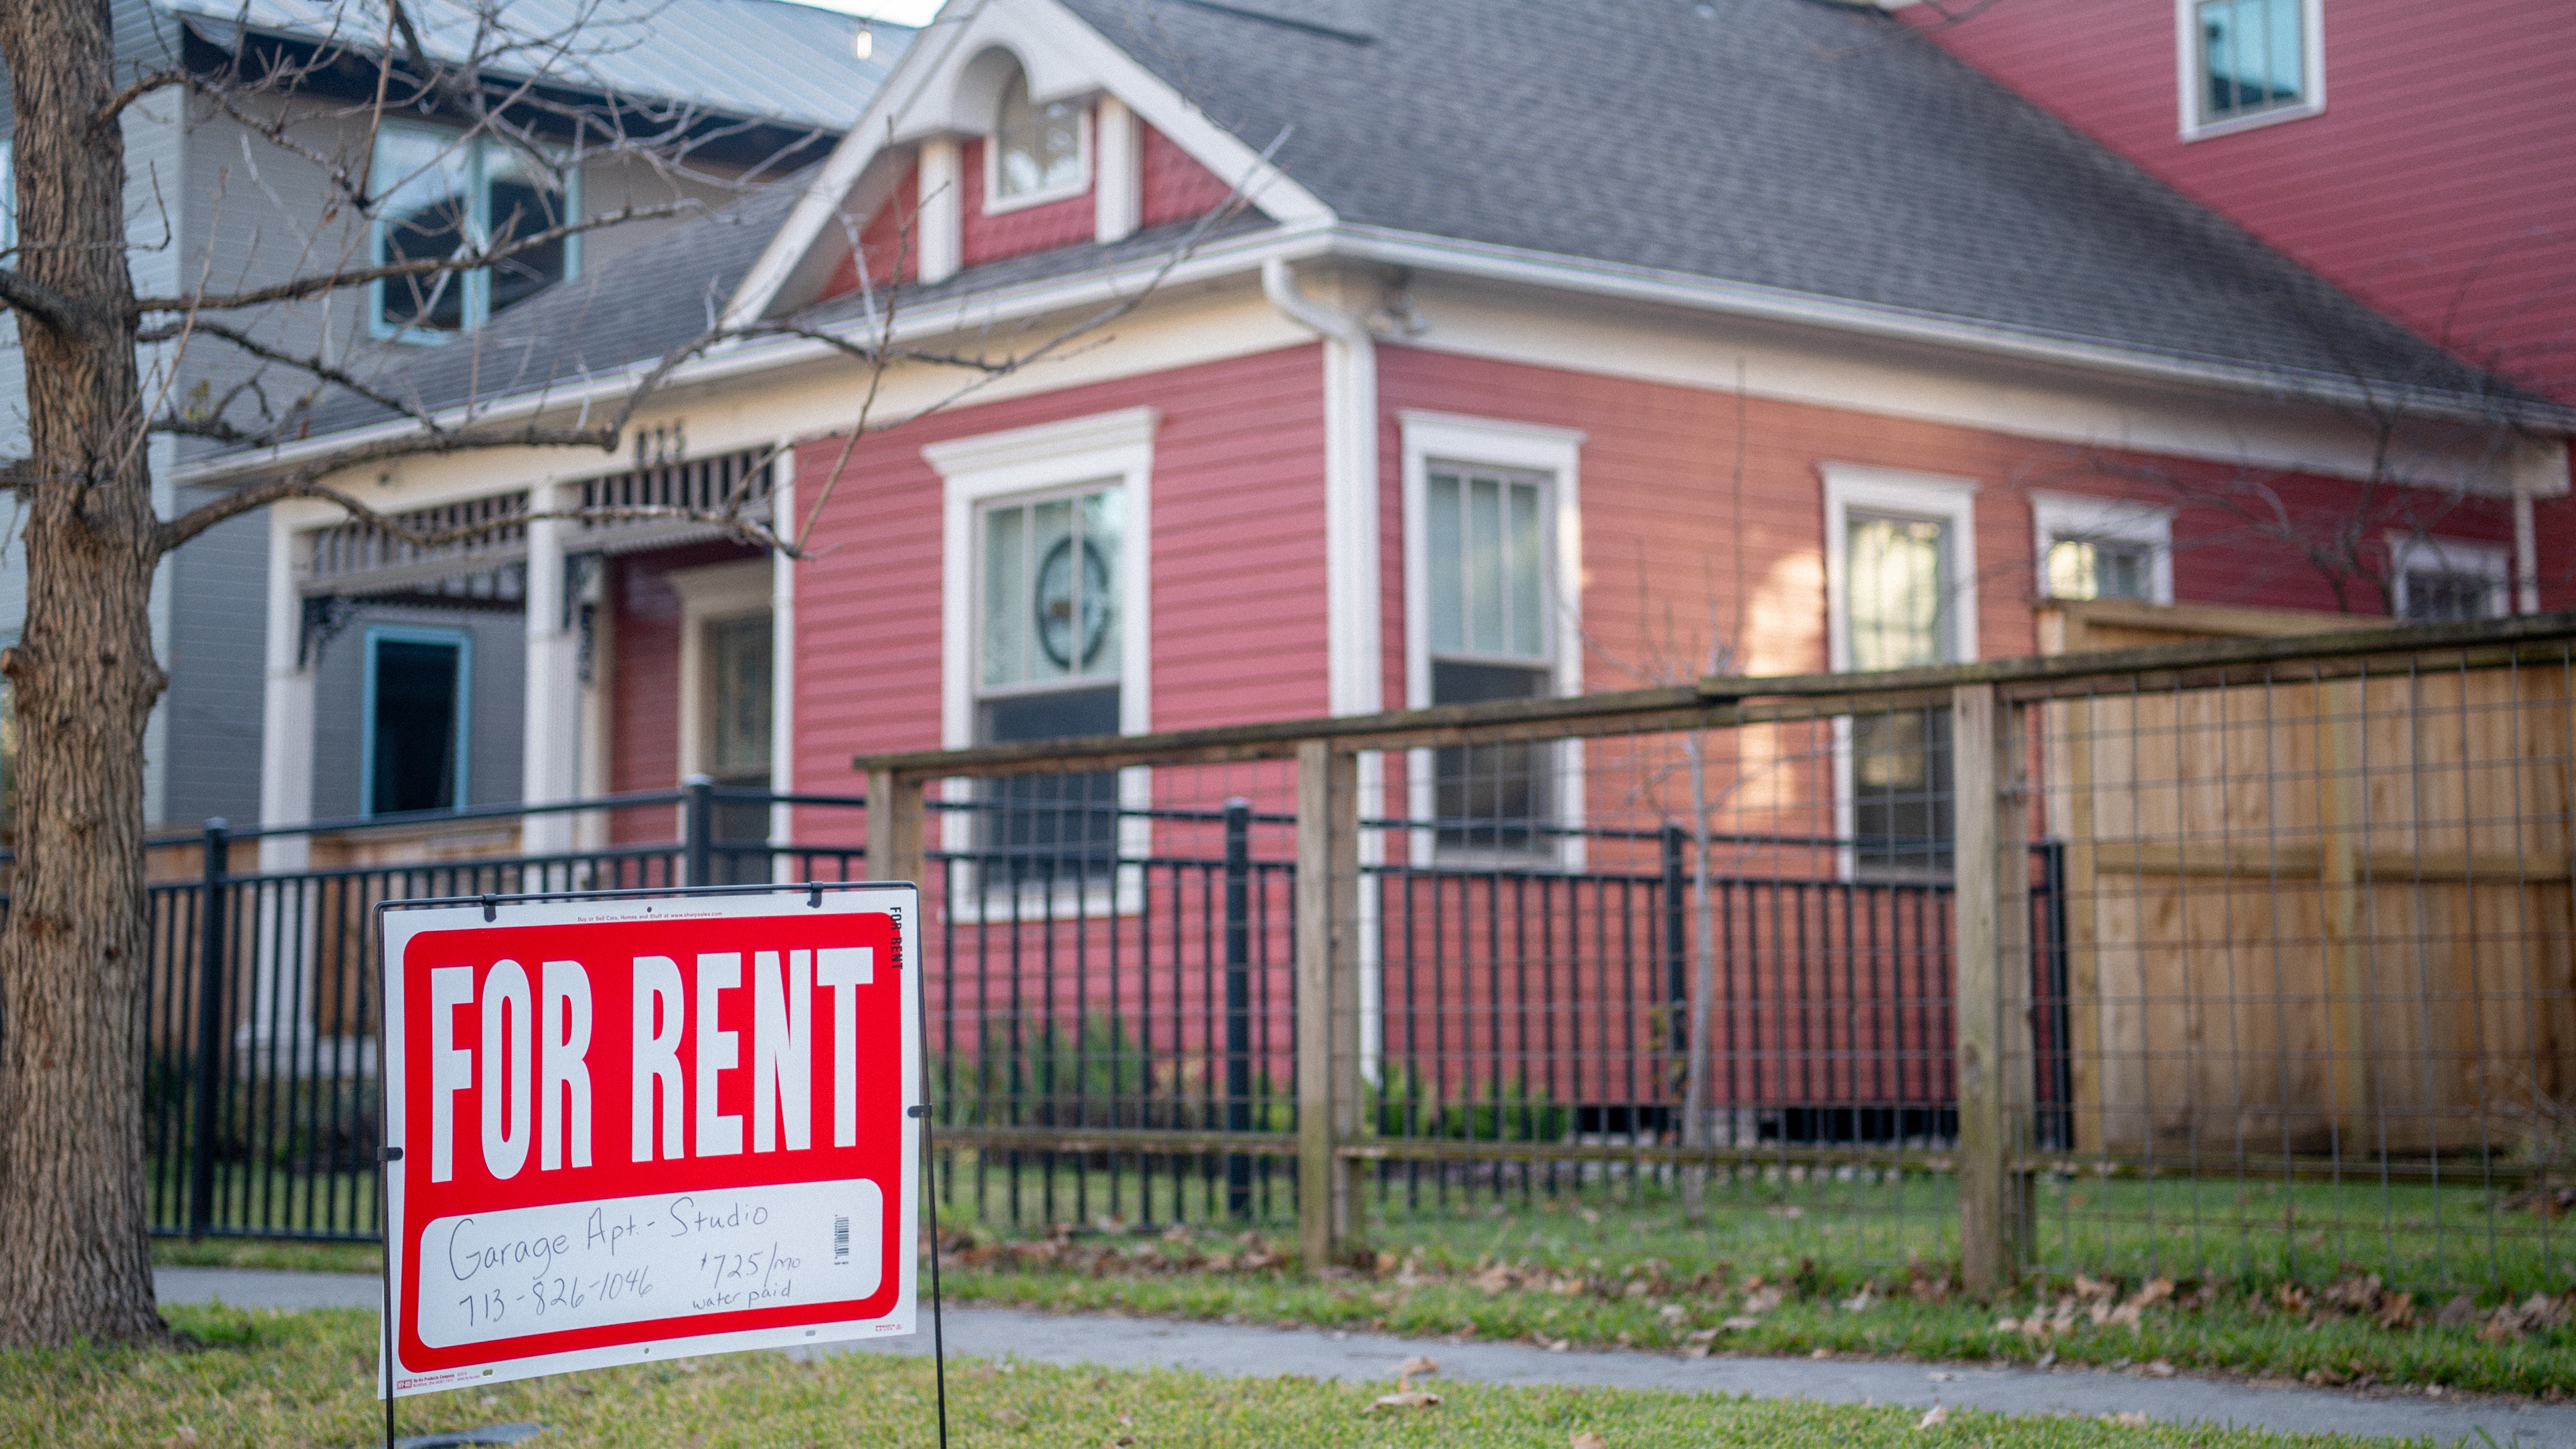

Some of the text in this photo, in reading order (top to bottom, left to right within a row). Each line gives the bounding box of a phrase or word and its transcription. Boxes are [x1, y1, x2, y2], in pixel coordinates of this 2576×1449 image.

[890, 907, 903, 970] FOR RENT
[431, 947, 873, 1183] FOR RENT
[449, 1218, 569, 1281] Garage
[670, 1197, 768, 1237] Studio
[459, 1265, 653, 1326] 713-826-1046
[693, 1280, 791, 1310] water paid
